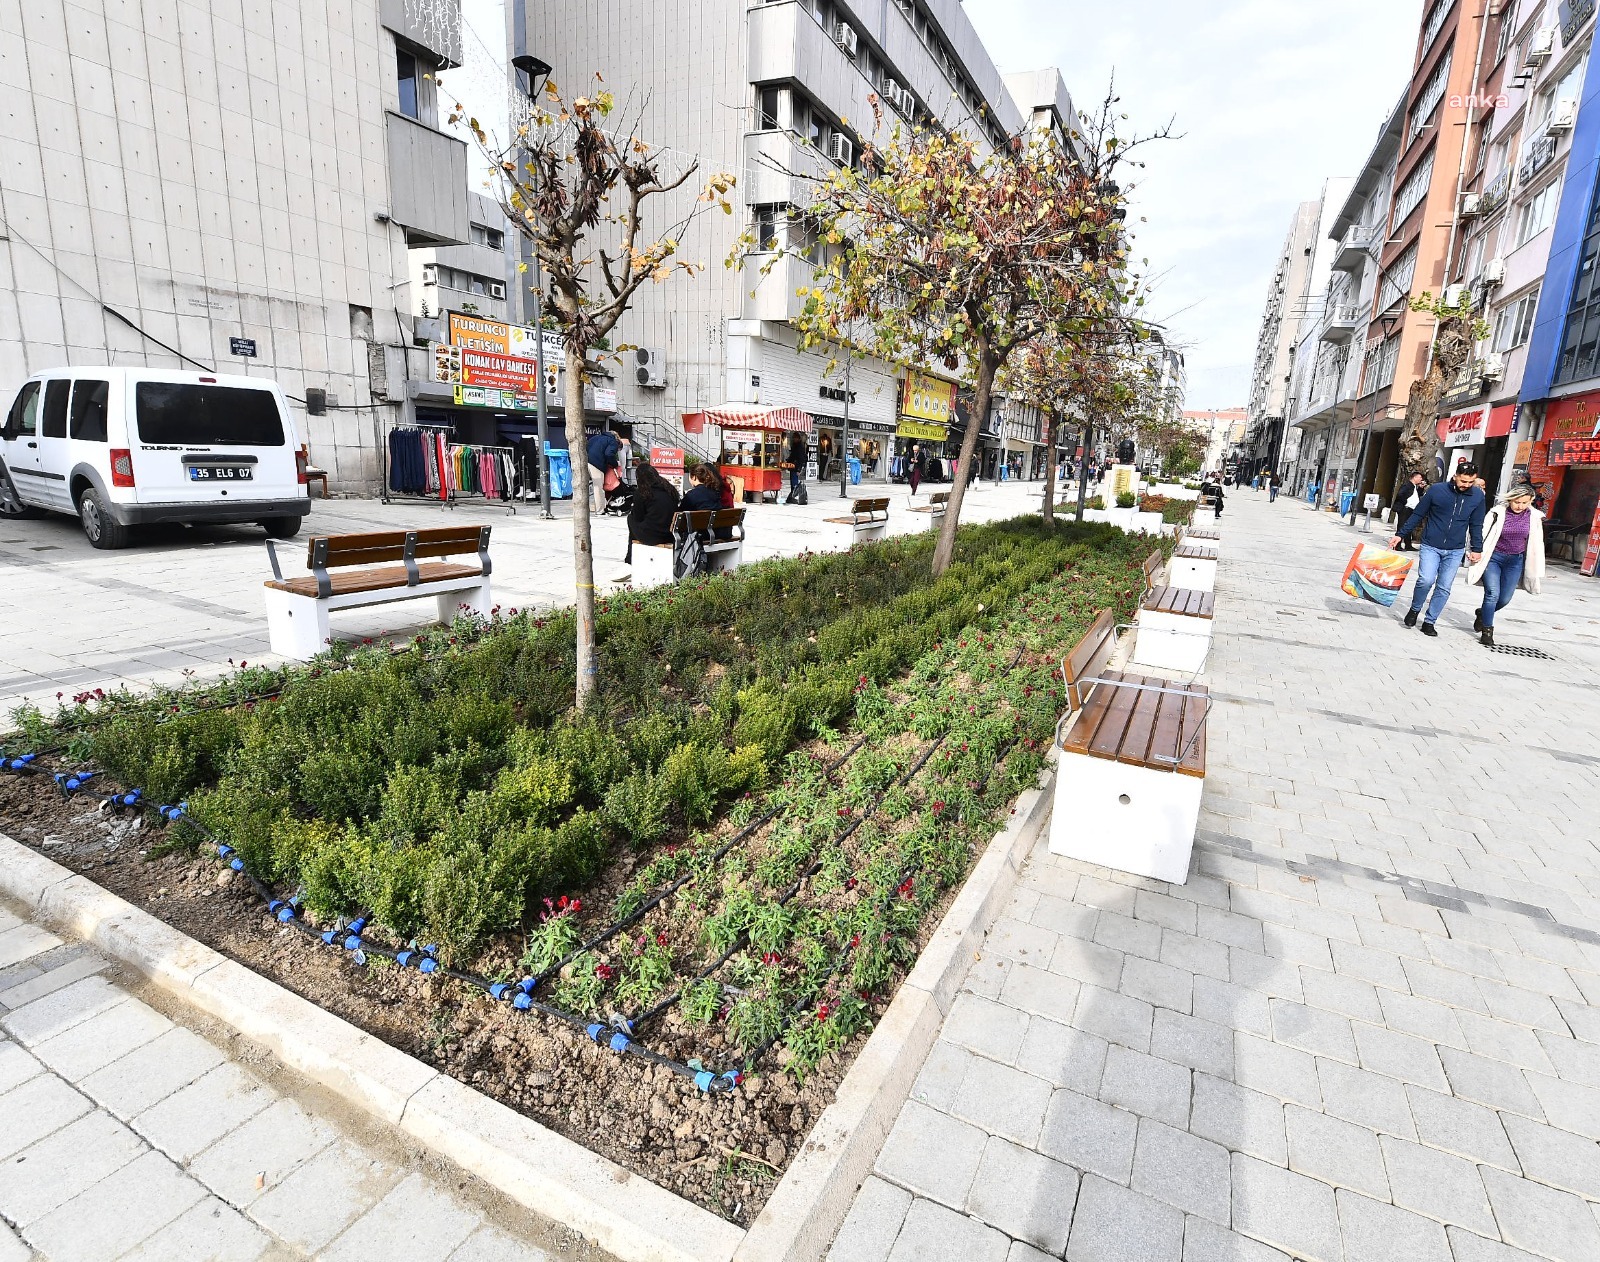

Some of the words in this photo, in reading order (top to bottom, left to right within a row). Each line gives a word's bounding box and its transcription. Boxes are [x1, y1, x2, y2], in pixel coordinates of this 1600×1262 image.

[452, 318, 506, 337] TURUNCU
[1448, 409, 1484, 433] ECZANE
[1563, 440, 1600, 451] FOTO
[197, 468, 209, 478] 35
[239, 468, 250, 478] 07
[1363, 567, 1397, 587] YKM
